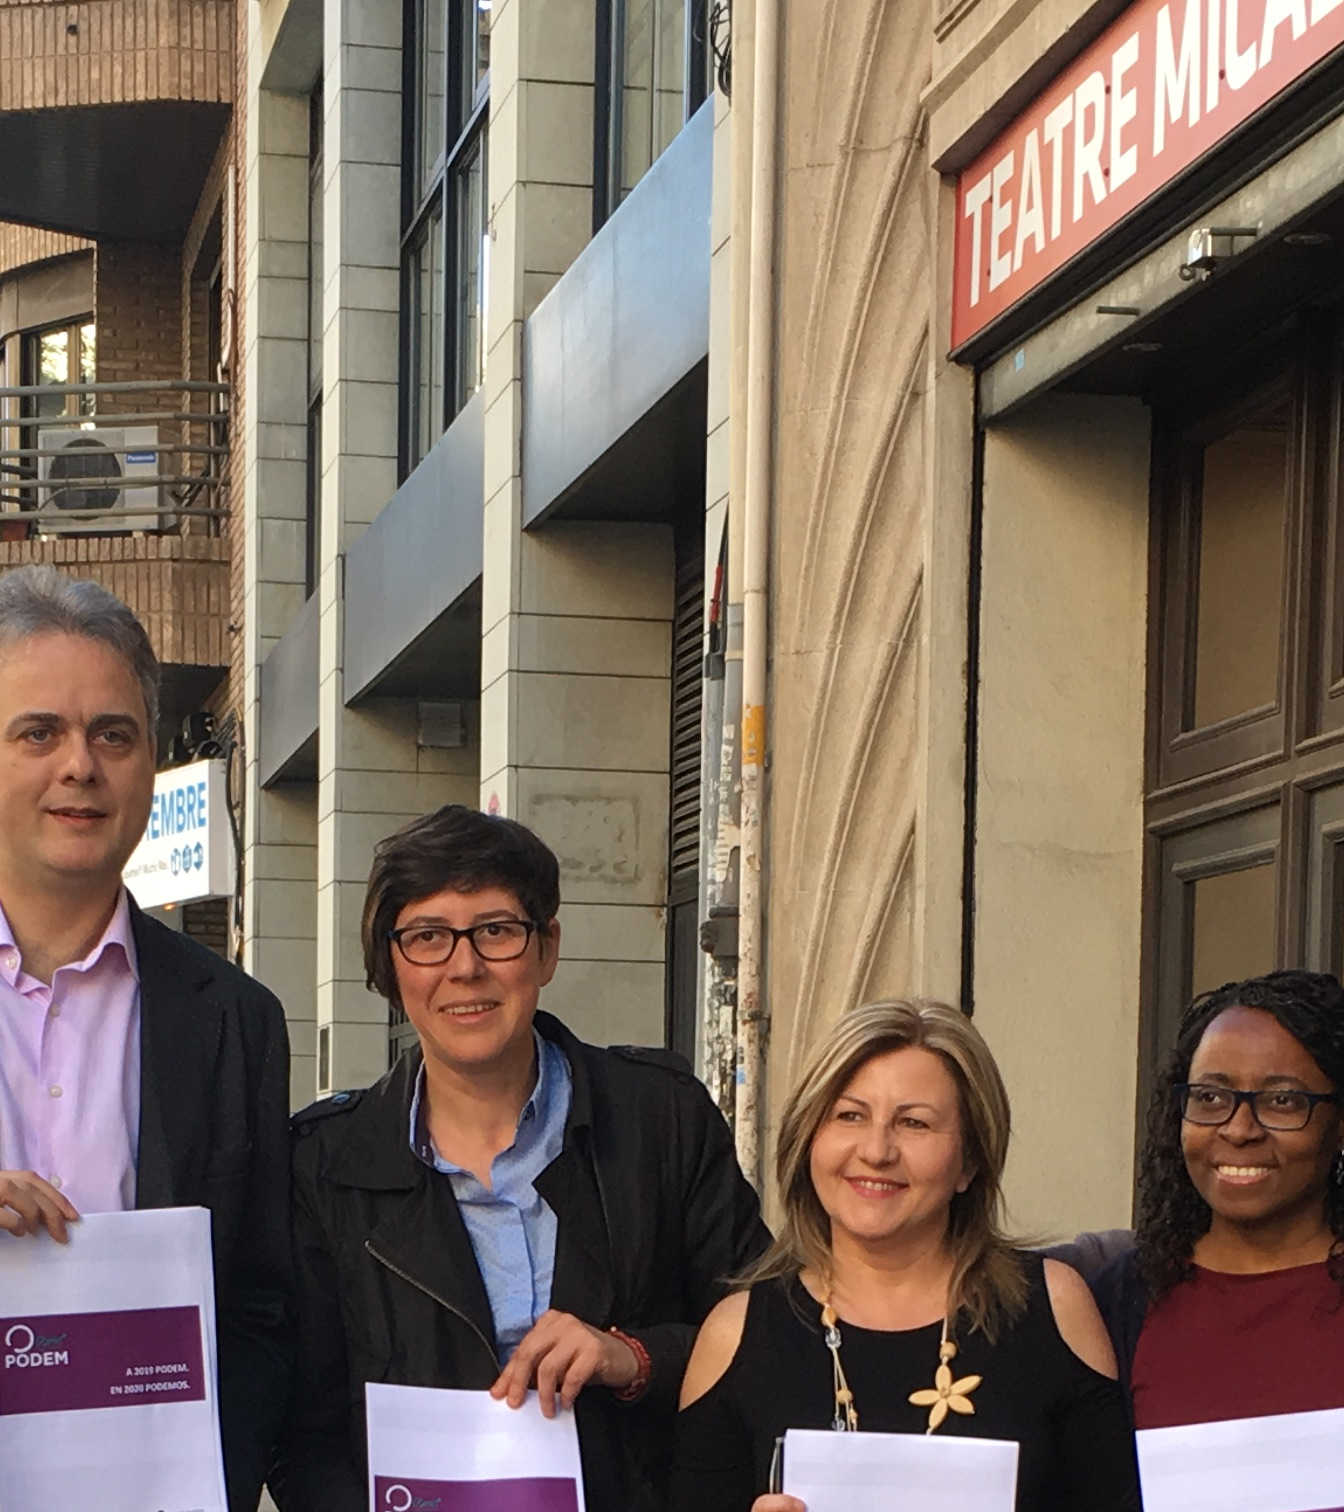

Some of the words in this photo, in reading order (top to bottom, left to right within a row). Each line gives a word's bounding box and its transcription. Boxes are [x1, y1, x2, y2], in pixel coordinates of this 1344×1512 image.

[964, 31, 1139, 308] TEATRE
[1153, 0, 1344, 157] MIC
[147, 782, 206, 840] EMBRE
[5, 1350, 68, 1369] PODEM
[126, 1368, 133, 1376] A
[110, 1386, 122, 1394] EN
